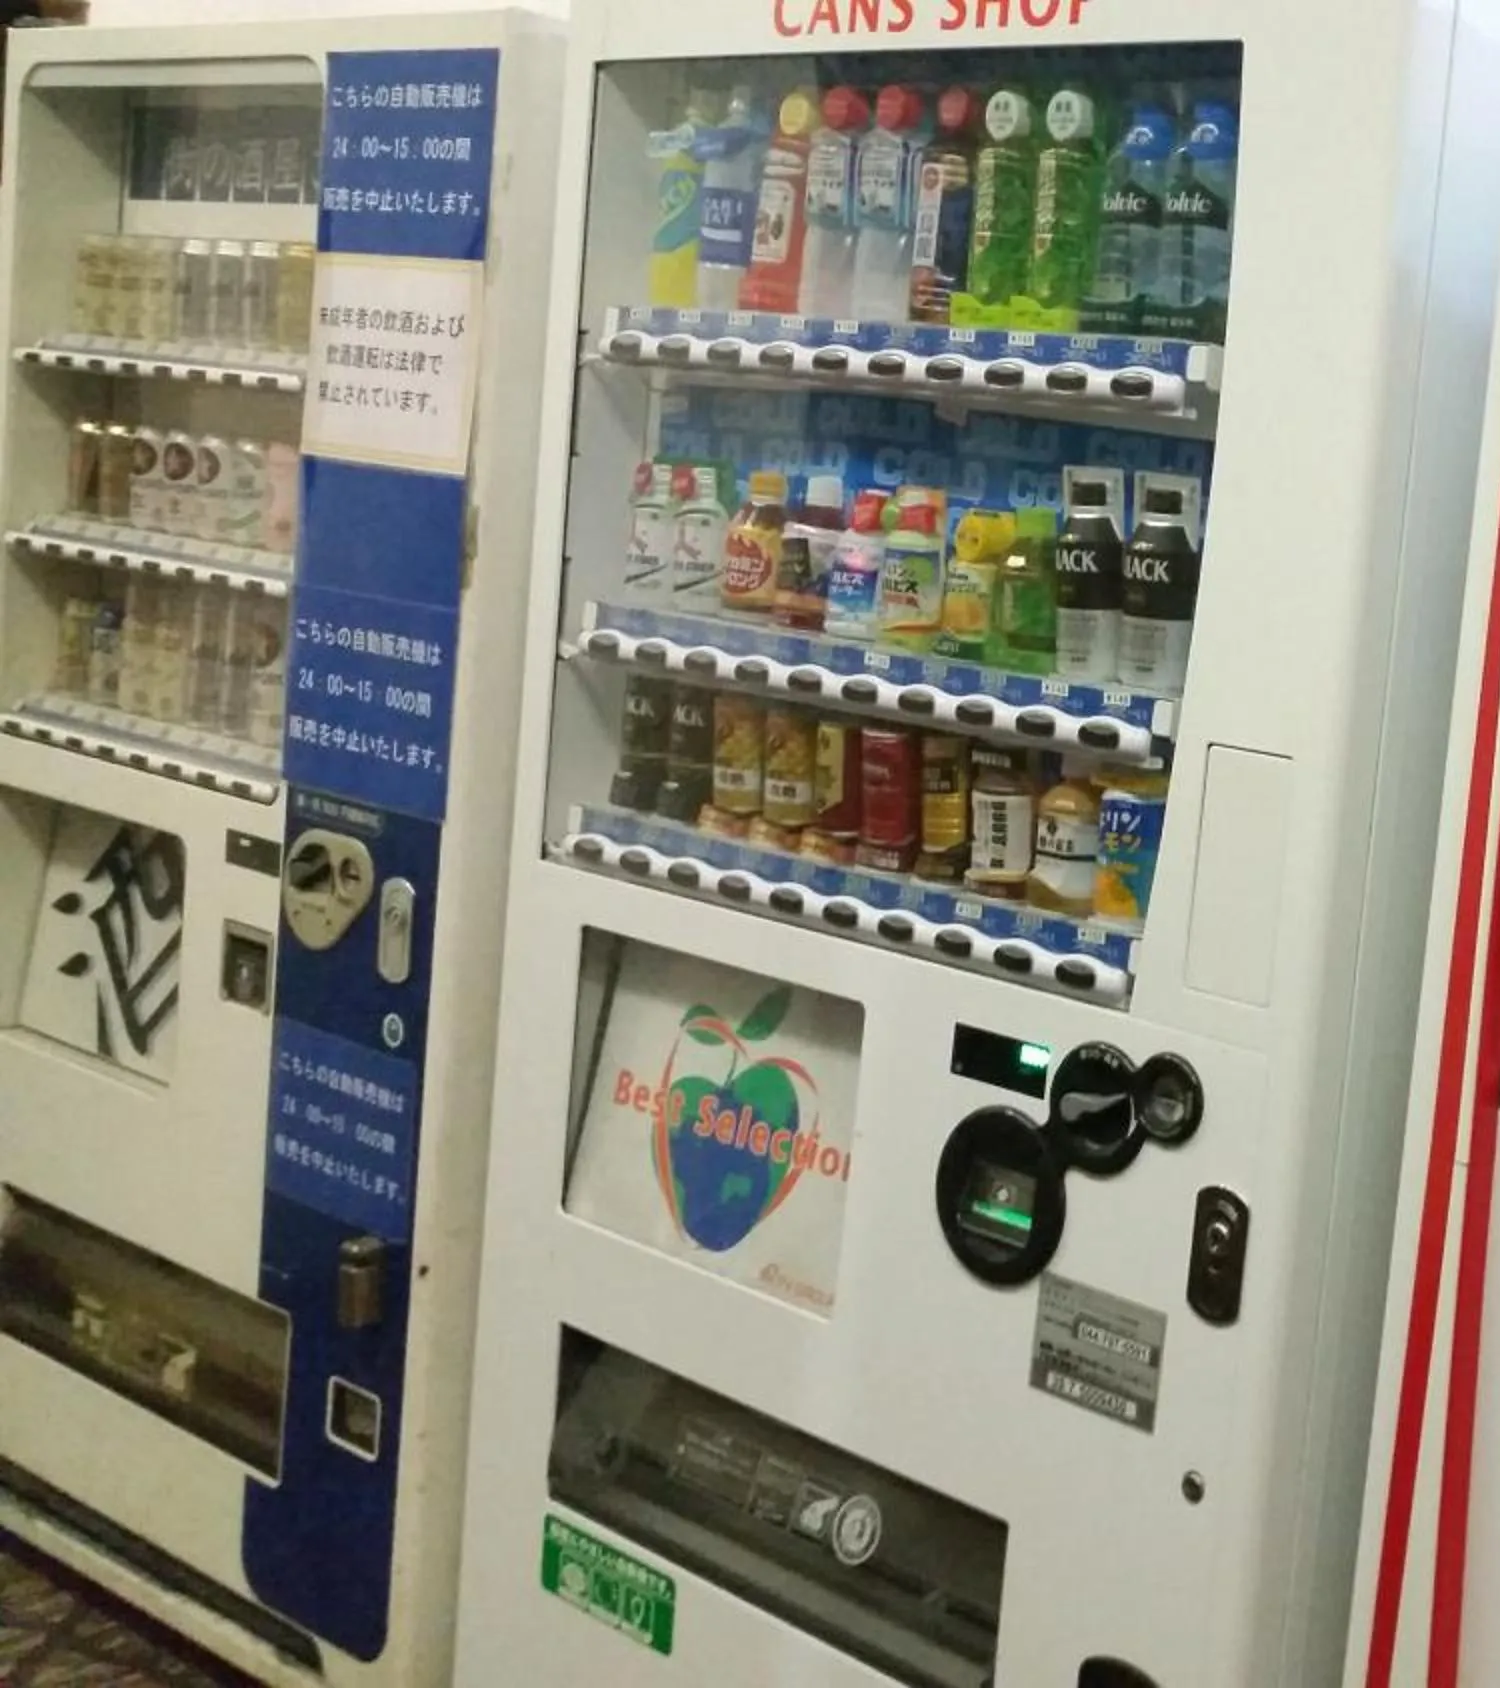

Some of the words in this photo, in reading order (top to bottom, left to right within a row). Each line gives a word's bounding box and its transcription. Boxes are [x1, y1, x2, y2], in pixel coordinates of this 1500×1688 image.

[773, 0, 916, 37] CANS
[332, 83, 482, 109] こちらの自動販売機は
[323, 187, 482, 217] 販売を中止いたします。
[319, 305, 466, 339] 未成年者の飲酒および
[326, 344, 443, 376] 飲酒運転は法律で
[296, 618, 442, 666] こちらの自動販売機は
[289, 715, 444, 774] 販売を中止いたします。
[613, 1068, 685, 1128] Best
